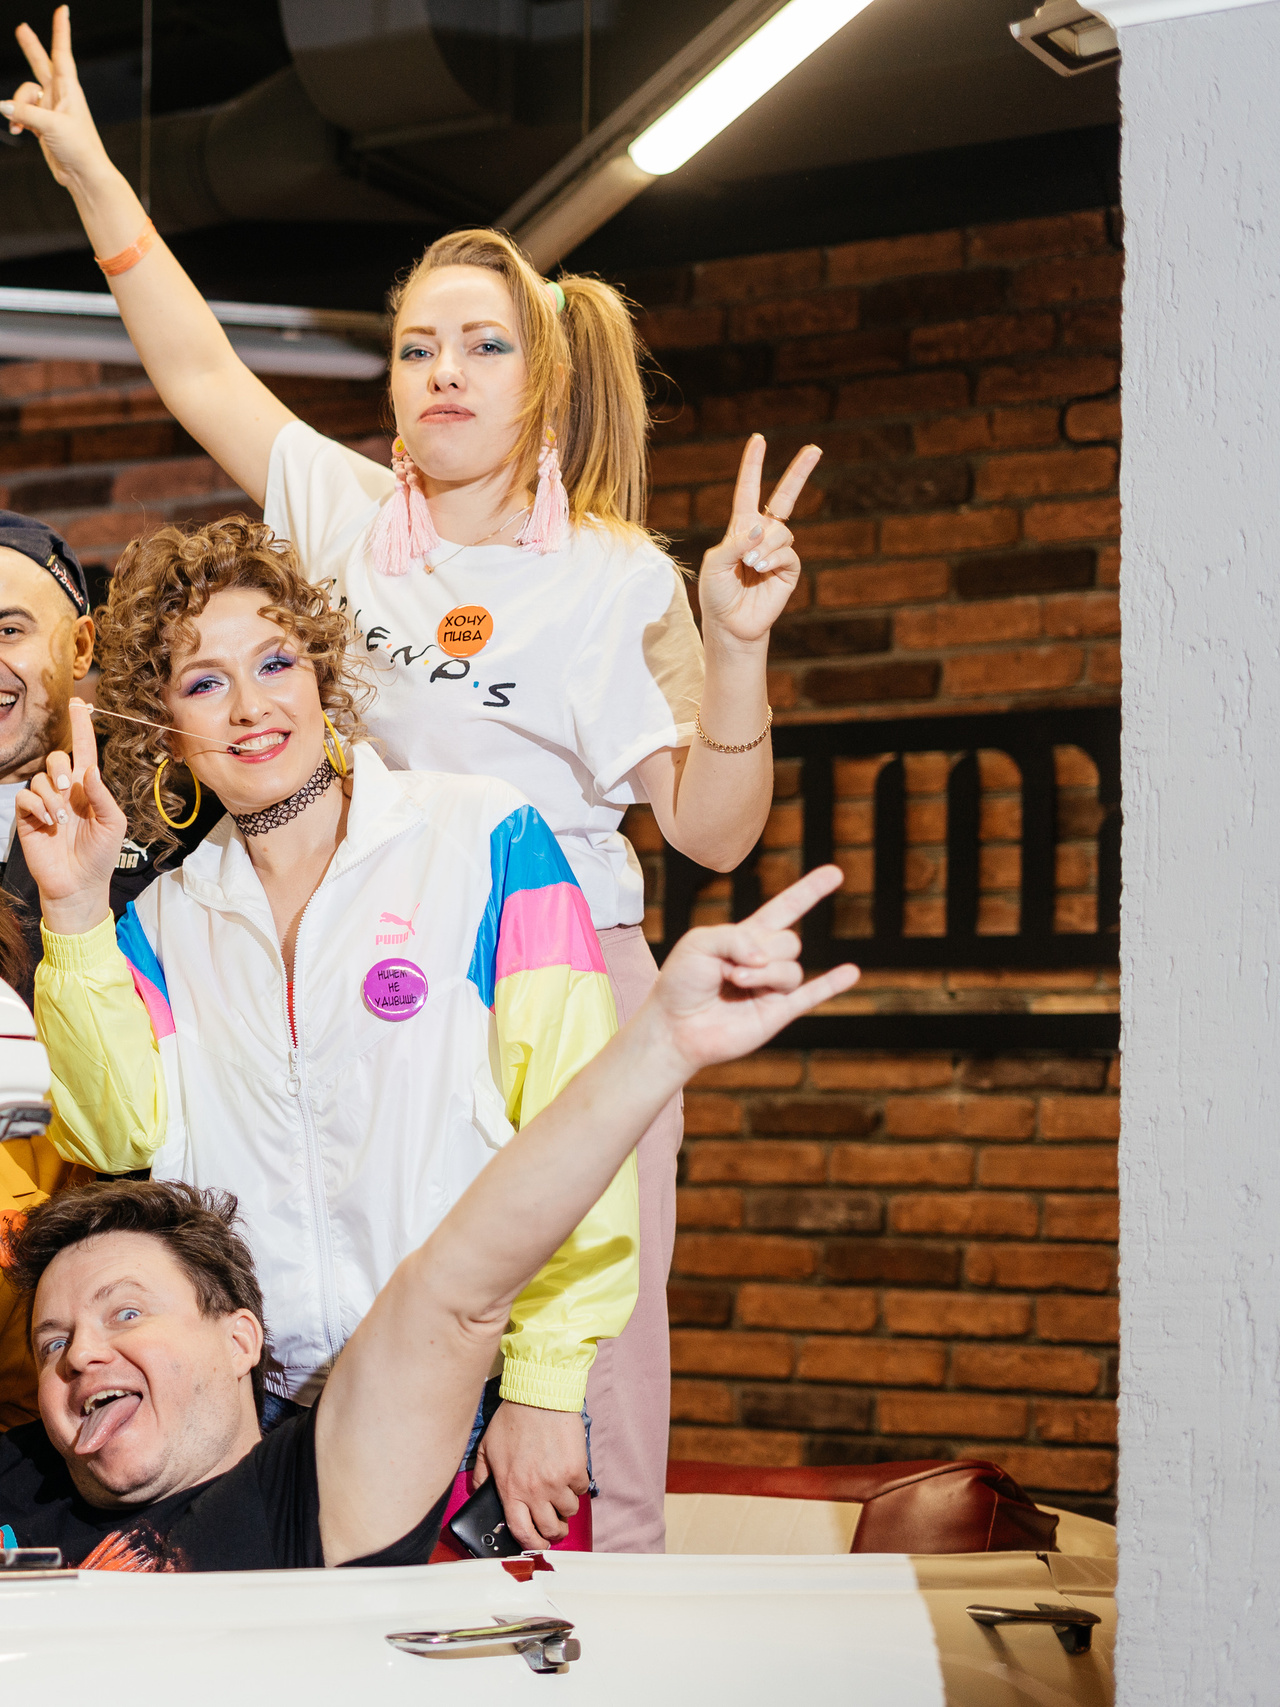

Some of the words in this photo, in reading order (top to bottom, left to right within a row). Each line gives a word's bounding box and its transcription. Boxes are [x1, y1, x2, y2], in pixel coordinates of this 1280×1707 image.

[444, 614, 487, 628] ХОЧУ
[443, 630, 483, 643] ПИВА
[375, 931, 409, 946] PUMA
[377, 969, 408, 981] НИЧЕМ
[388, 981, 400, 993] НЕ
[374, 993, 418, 1008] УДИВИШЬ
